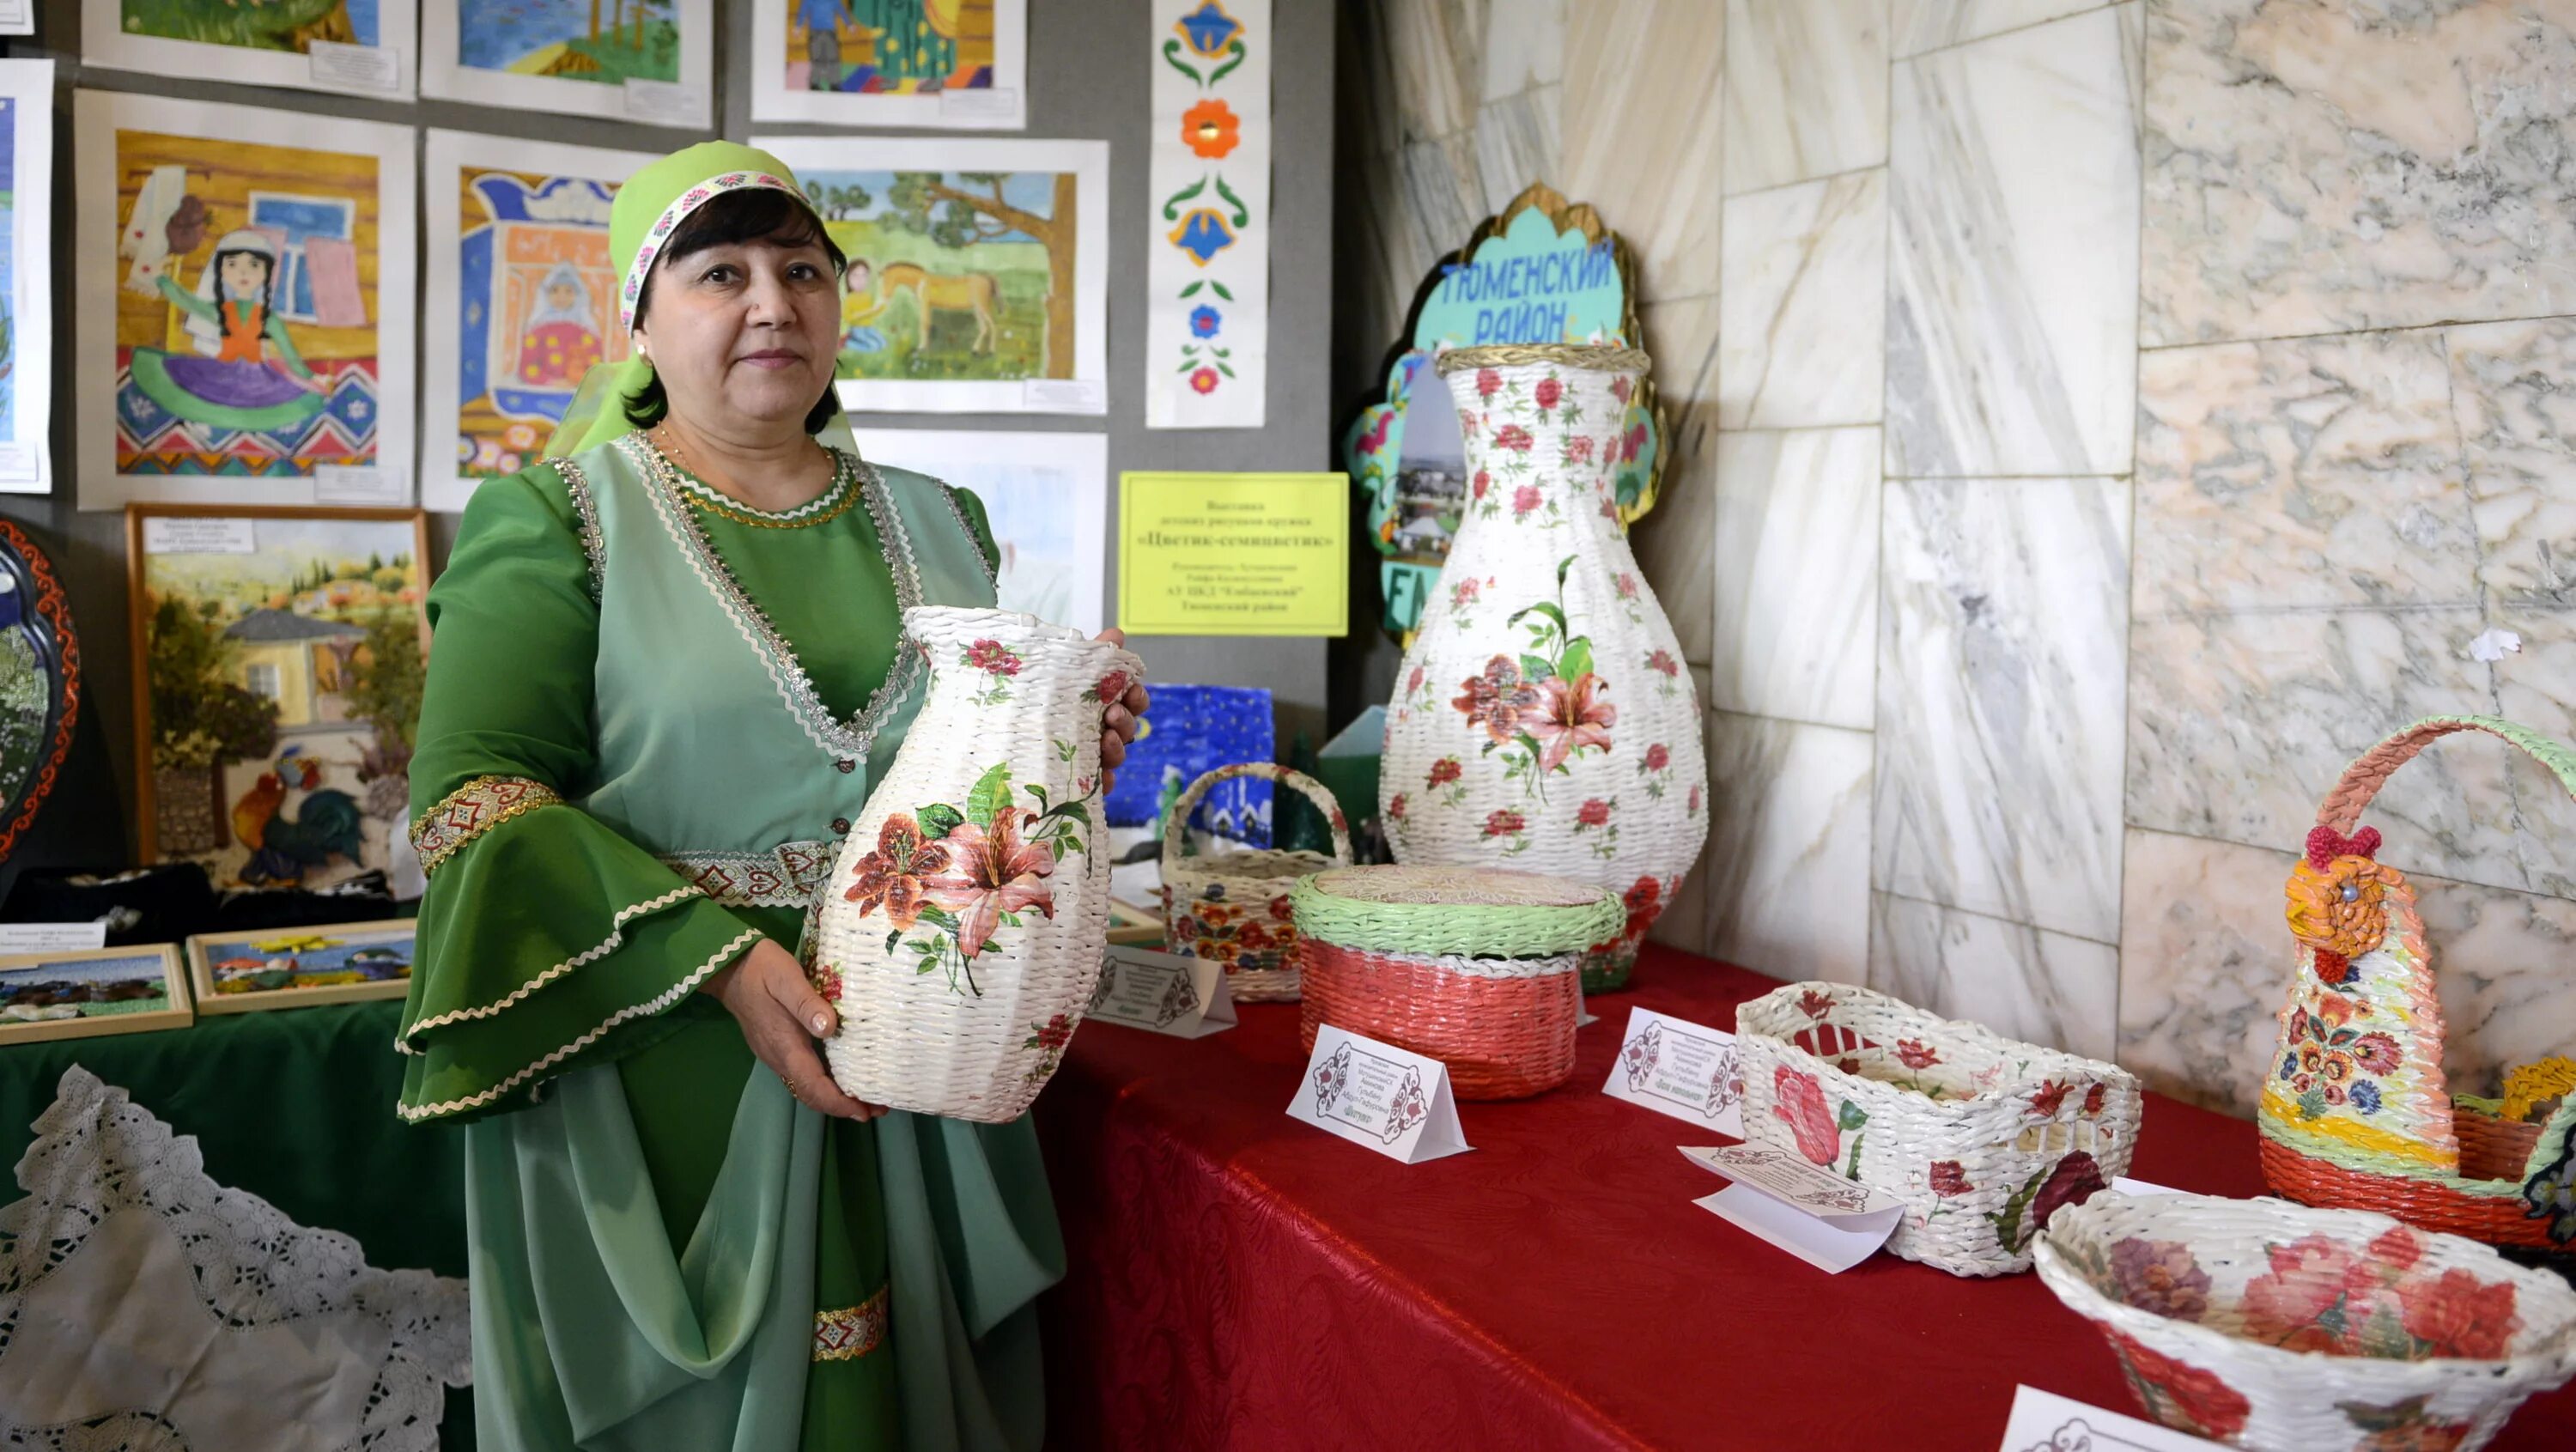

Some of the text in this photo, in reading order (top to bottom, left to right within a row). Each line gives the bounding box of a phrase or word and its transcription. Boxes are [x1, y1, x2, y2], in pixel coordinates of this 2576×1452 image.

[1440, 236, 1614, 303] ТЮМЕНСКИЙ
[1474, 301, 1567, 345] РАЙОН
[1138, 532, 1334, 548] «Цветик-семицветик»
